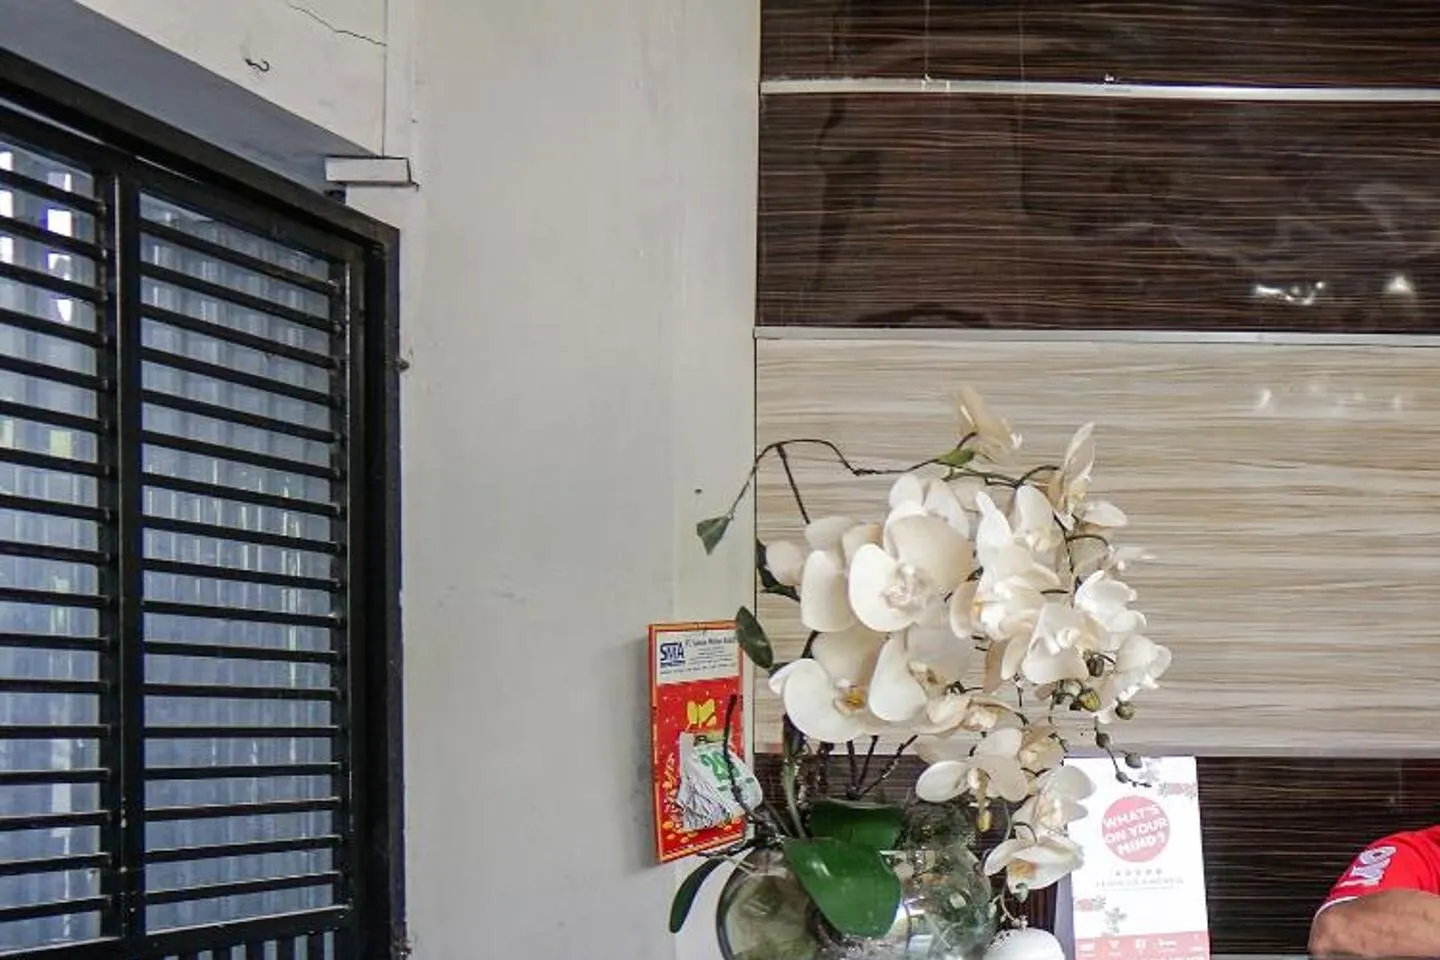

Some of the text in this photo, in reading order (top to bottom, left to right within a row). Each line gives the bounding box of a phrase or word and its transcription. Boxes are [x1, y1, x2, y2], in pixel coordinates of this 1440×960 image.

[660, 641, 685, 661] SMA
[1105, 817, 1168, 844] ON YOUR
